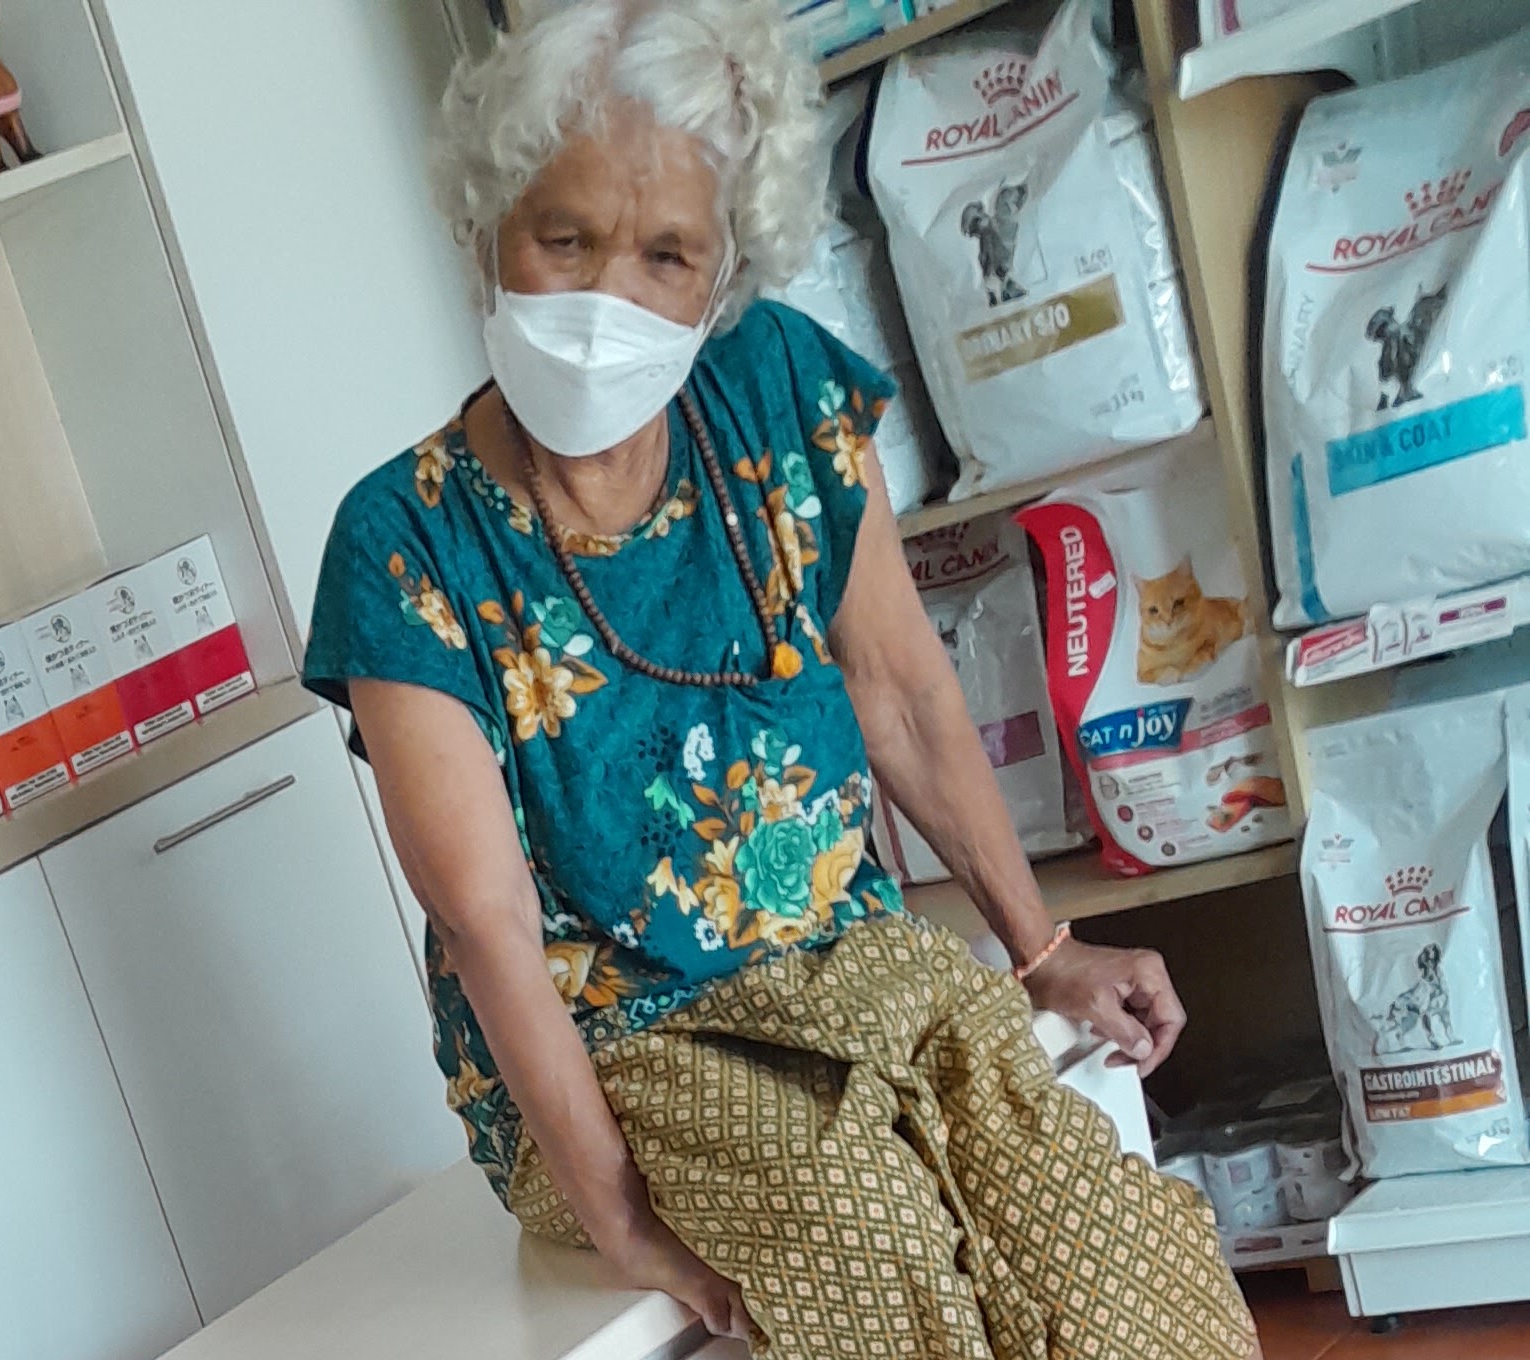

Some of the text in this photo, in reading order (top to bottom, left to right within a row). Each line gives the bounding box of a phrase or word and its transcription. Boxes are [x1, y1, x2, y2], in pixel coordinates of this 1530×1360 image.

[926, 69, 1063, 151] ROYAL ANIN
[1334, 224, 1419, 261] ROYAL
[1398, 413, 1454, 450] COAT
[1060, 525, 1090, 677] NEUTERED
[1079, 706, 1178, 748] CAT n joy
[1334, 901, 1396, 925] ROYAL
[1363, 1055, 1496, 1091] GASTROINTESTINAL
